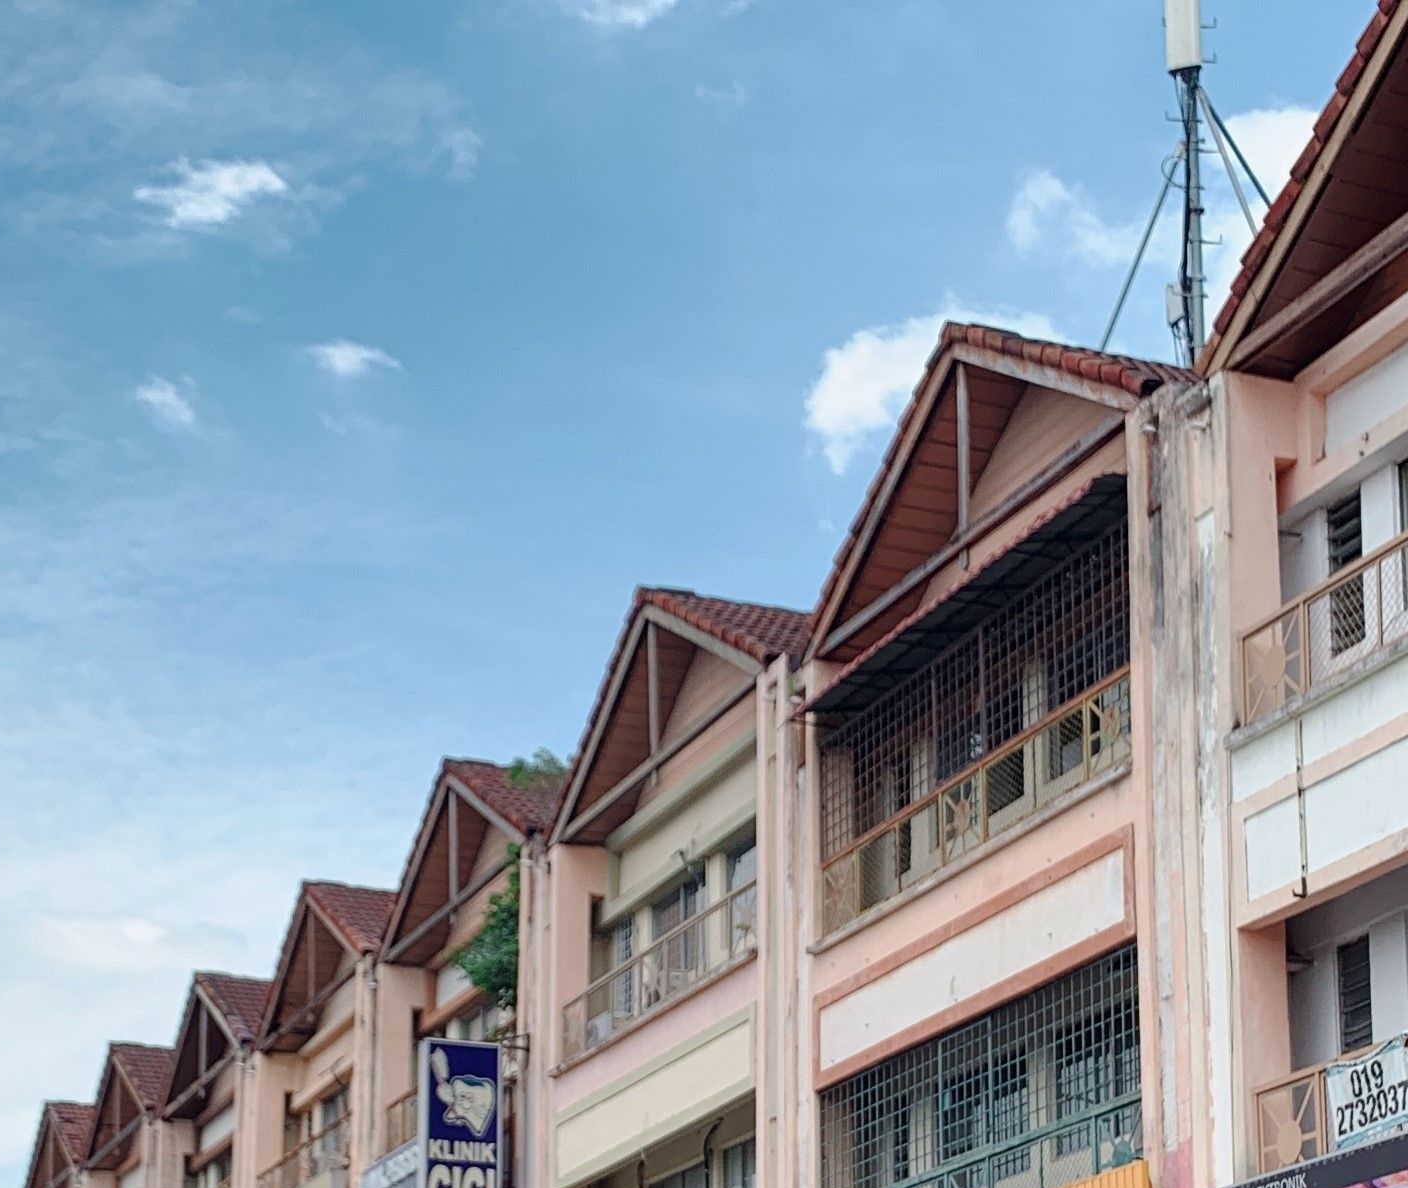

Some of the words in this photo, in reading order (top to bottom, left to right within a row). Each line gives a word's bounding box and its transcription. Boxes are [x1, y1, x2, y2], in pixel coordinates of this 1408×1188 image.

[1350, 1060, 1384, 1098] 019
[1336, 1080, 1408, 1137] 2732037
[428, 1138, 496, 1164] KLINIK
